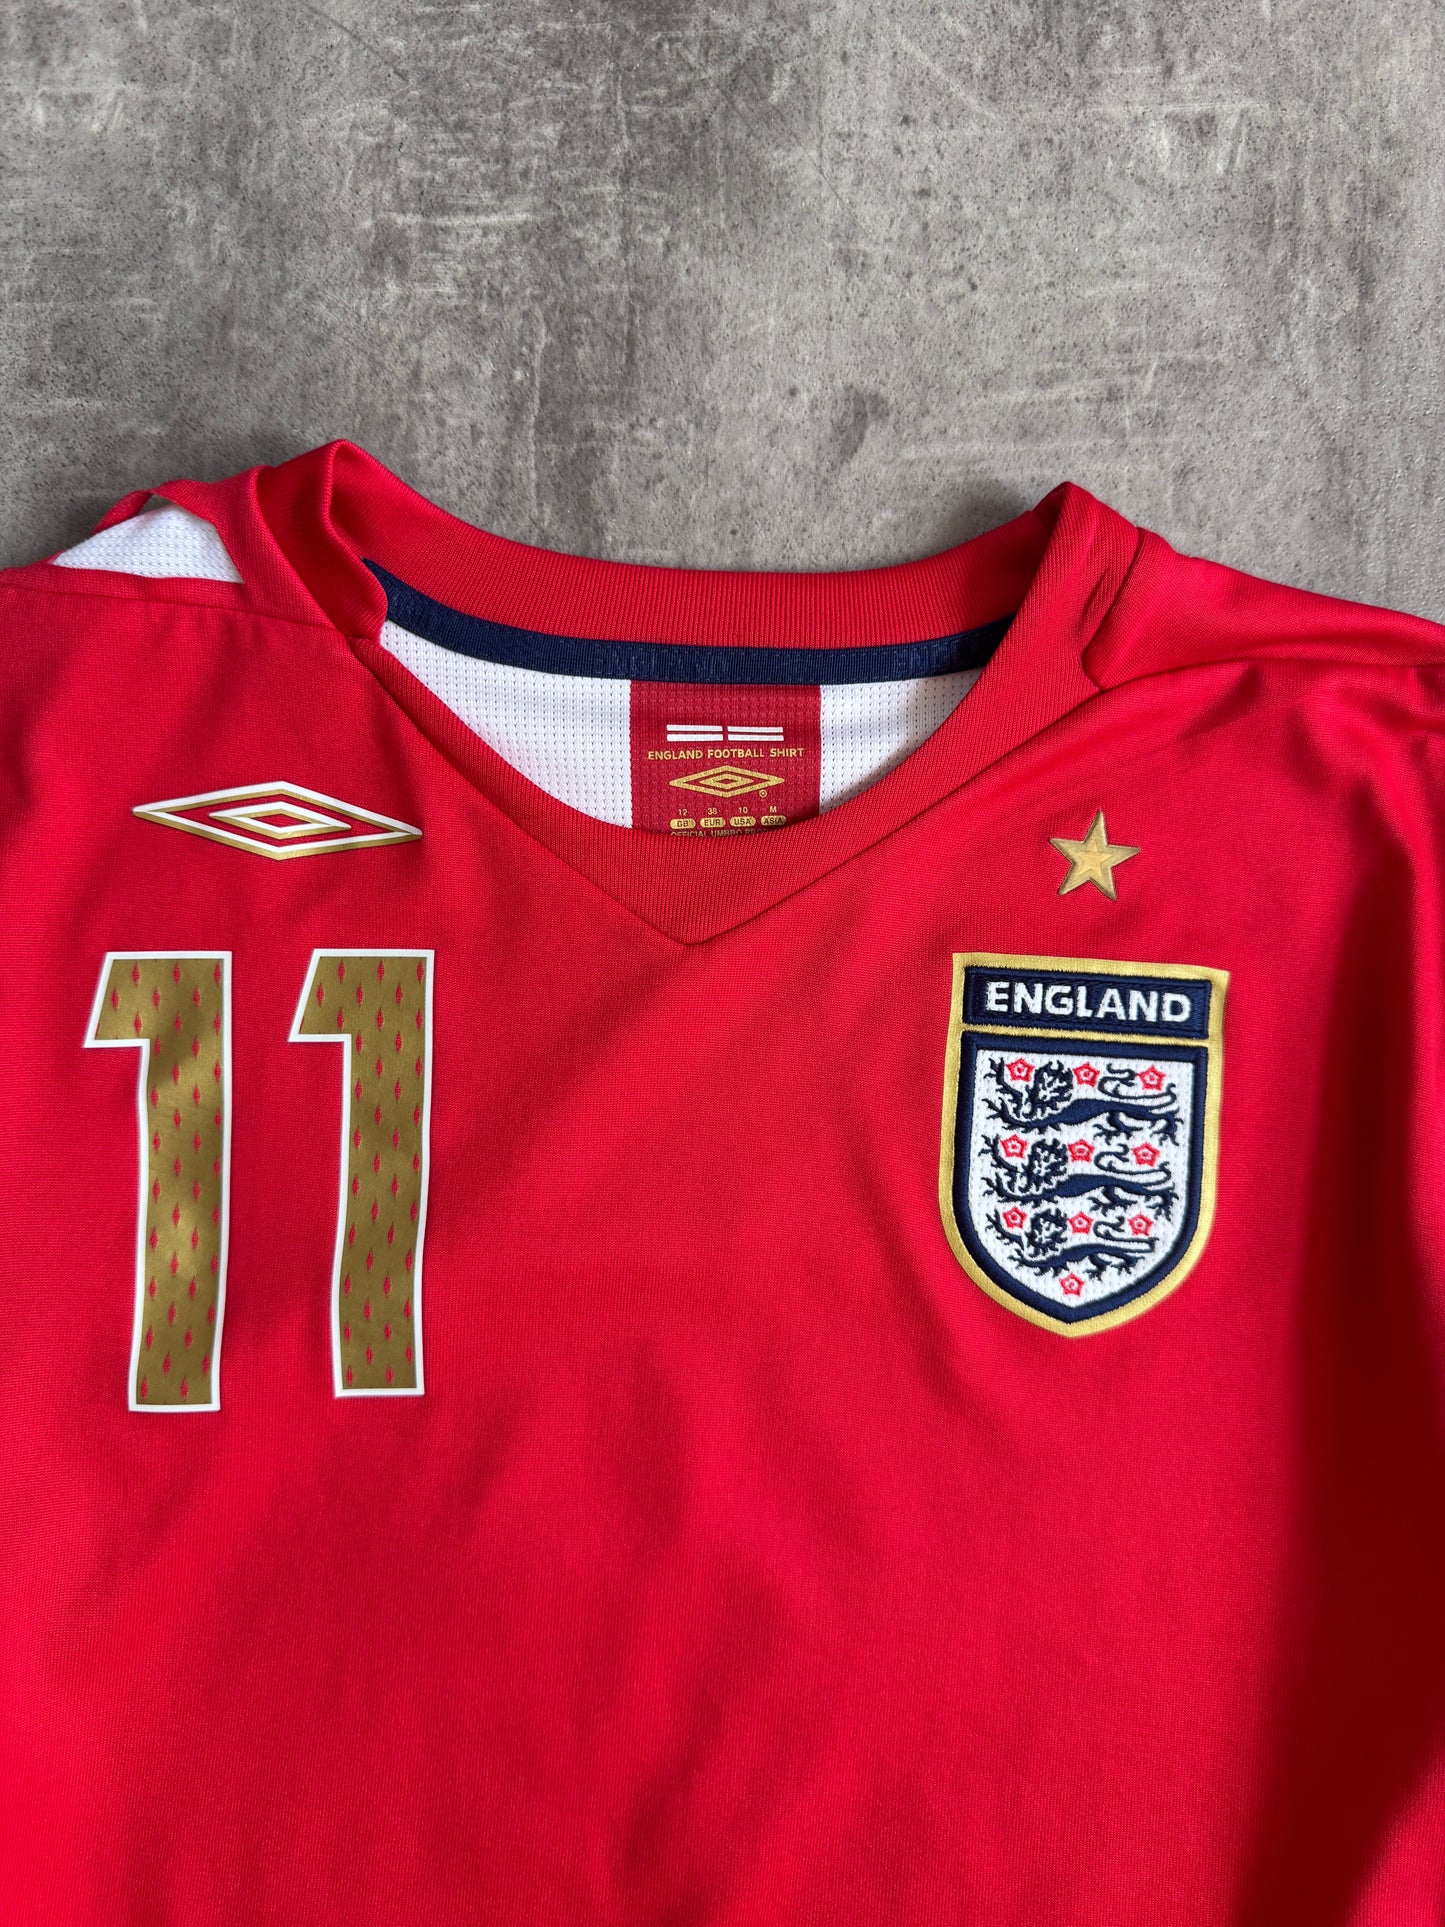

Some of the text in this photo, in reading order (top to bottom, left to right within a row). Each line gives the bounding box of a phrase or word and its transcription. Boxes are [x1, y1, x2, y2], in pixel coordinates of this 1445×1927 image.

[648, 747, 804, 760] ENGLAND FOOTBALL SHIRT
[704, 819, 721, 827] EUR
[734, 818, 751, 826] USA
[764, 817, 783, 825] ASIA
[985, 981, 1192, 1022] ENGLAND
[84, 949, 434, 1412] 11
